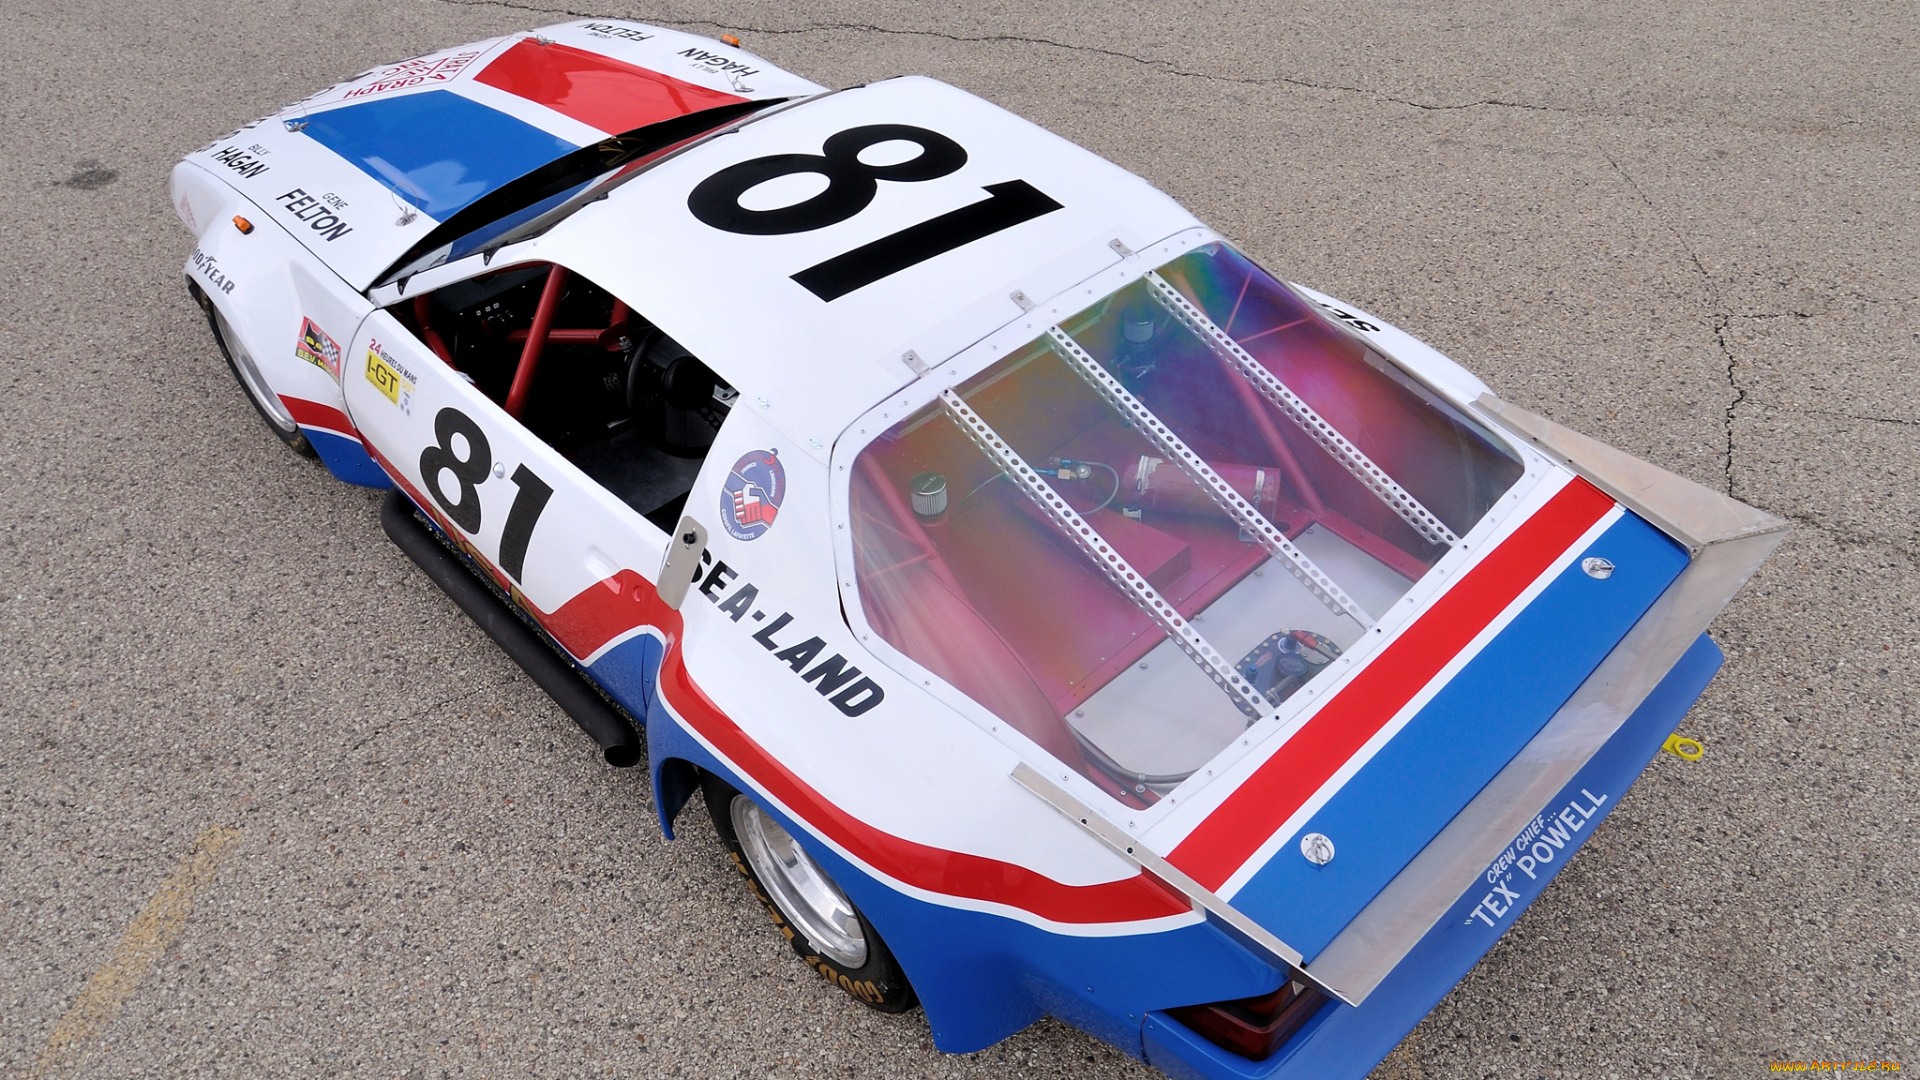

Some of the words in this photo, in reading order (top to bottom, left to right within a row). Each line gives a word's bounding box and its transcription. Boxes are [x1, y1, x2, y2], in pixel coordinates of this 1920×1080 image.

[577, 22, 655, 42] FELTON
[677, 47, 760, 77] HAGAN
[211, 146, 271, 179] HAGAN
[248, 143, 271, 156] BILLY
[276, 188, 353, 242] FELTON
[322, 192, 348, 210] GENE
[687, 123, 1064, 303] 81
[367, 355, 398, 393] I-GT
[369, 338, 382, 355] 24
[380, 350, 398, 369] HEURES
[396, 363, 404, 374] DU
[403, 369, 417, 384] MANS
[419, 407, 554, 586] 81
[1516, 788, 1608, 881] POWELL
[1486, 846, 1517, 884] CREW
